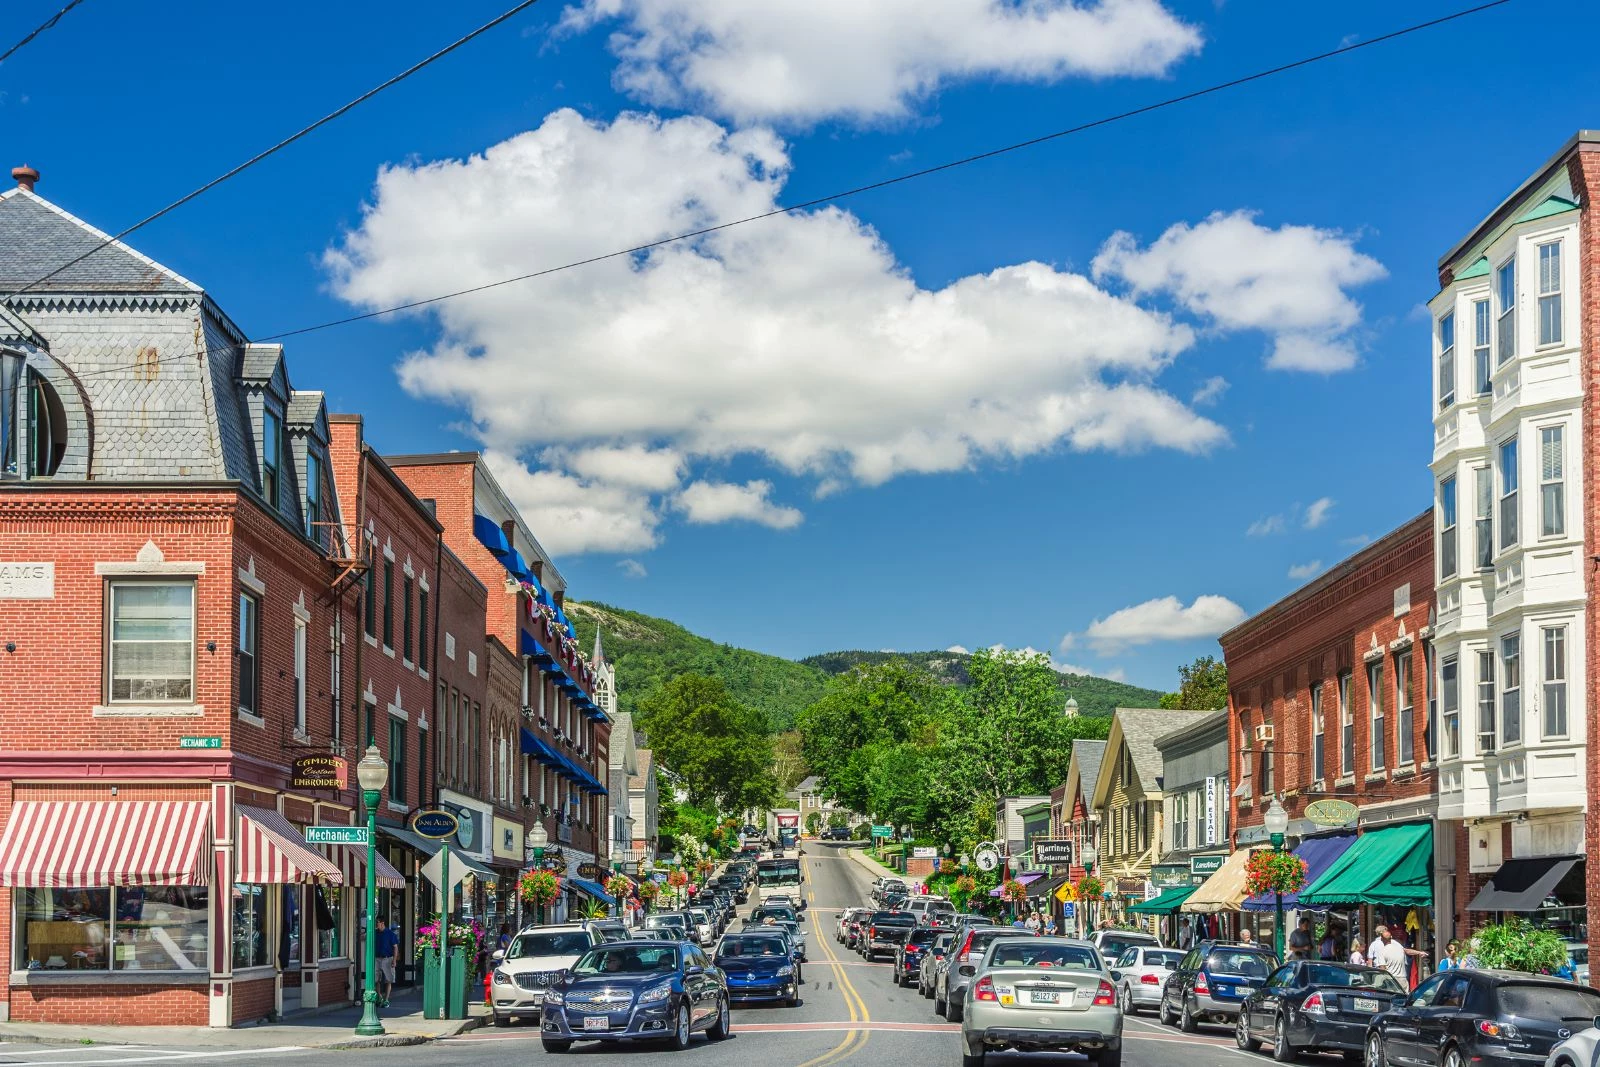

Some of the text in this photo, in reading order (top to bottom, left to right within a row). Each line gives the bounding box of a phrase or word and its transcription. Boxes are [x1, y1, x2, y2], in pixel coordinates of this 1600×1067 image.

[180, 738, 219, 748] MECHANIC ST
[296, 757, 343, 769] CAMDEN
[294, 778, 344, 788] EMBROIDERY
[1309, 807, 1357, 819] COLONY
[308, 829, 366, 841] Mechanic St
[1036, 844, 1071, 854] Marriner's
[1039, 853, 1069, 862] Restaurant
